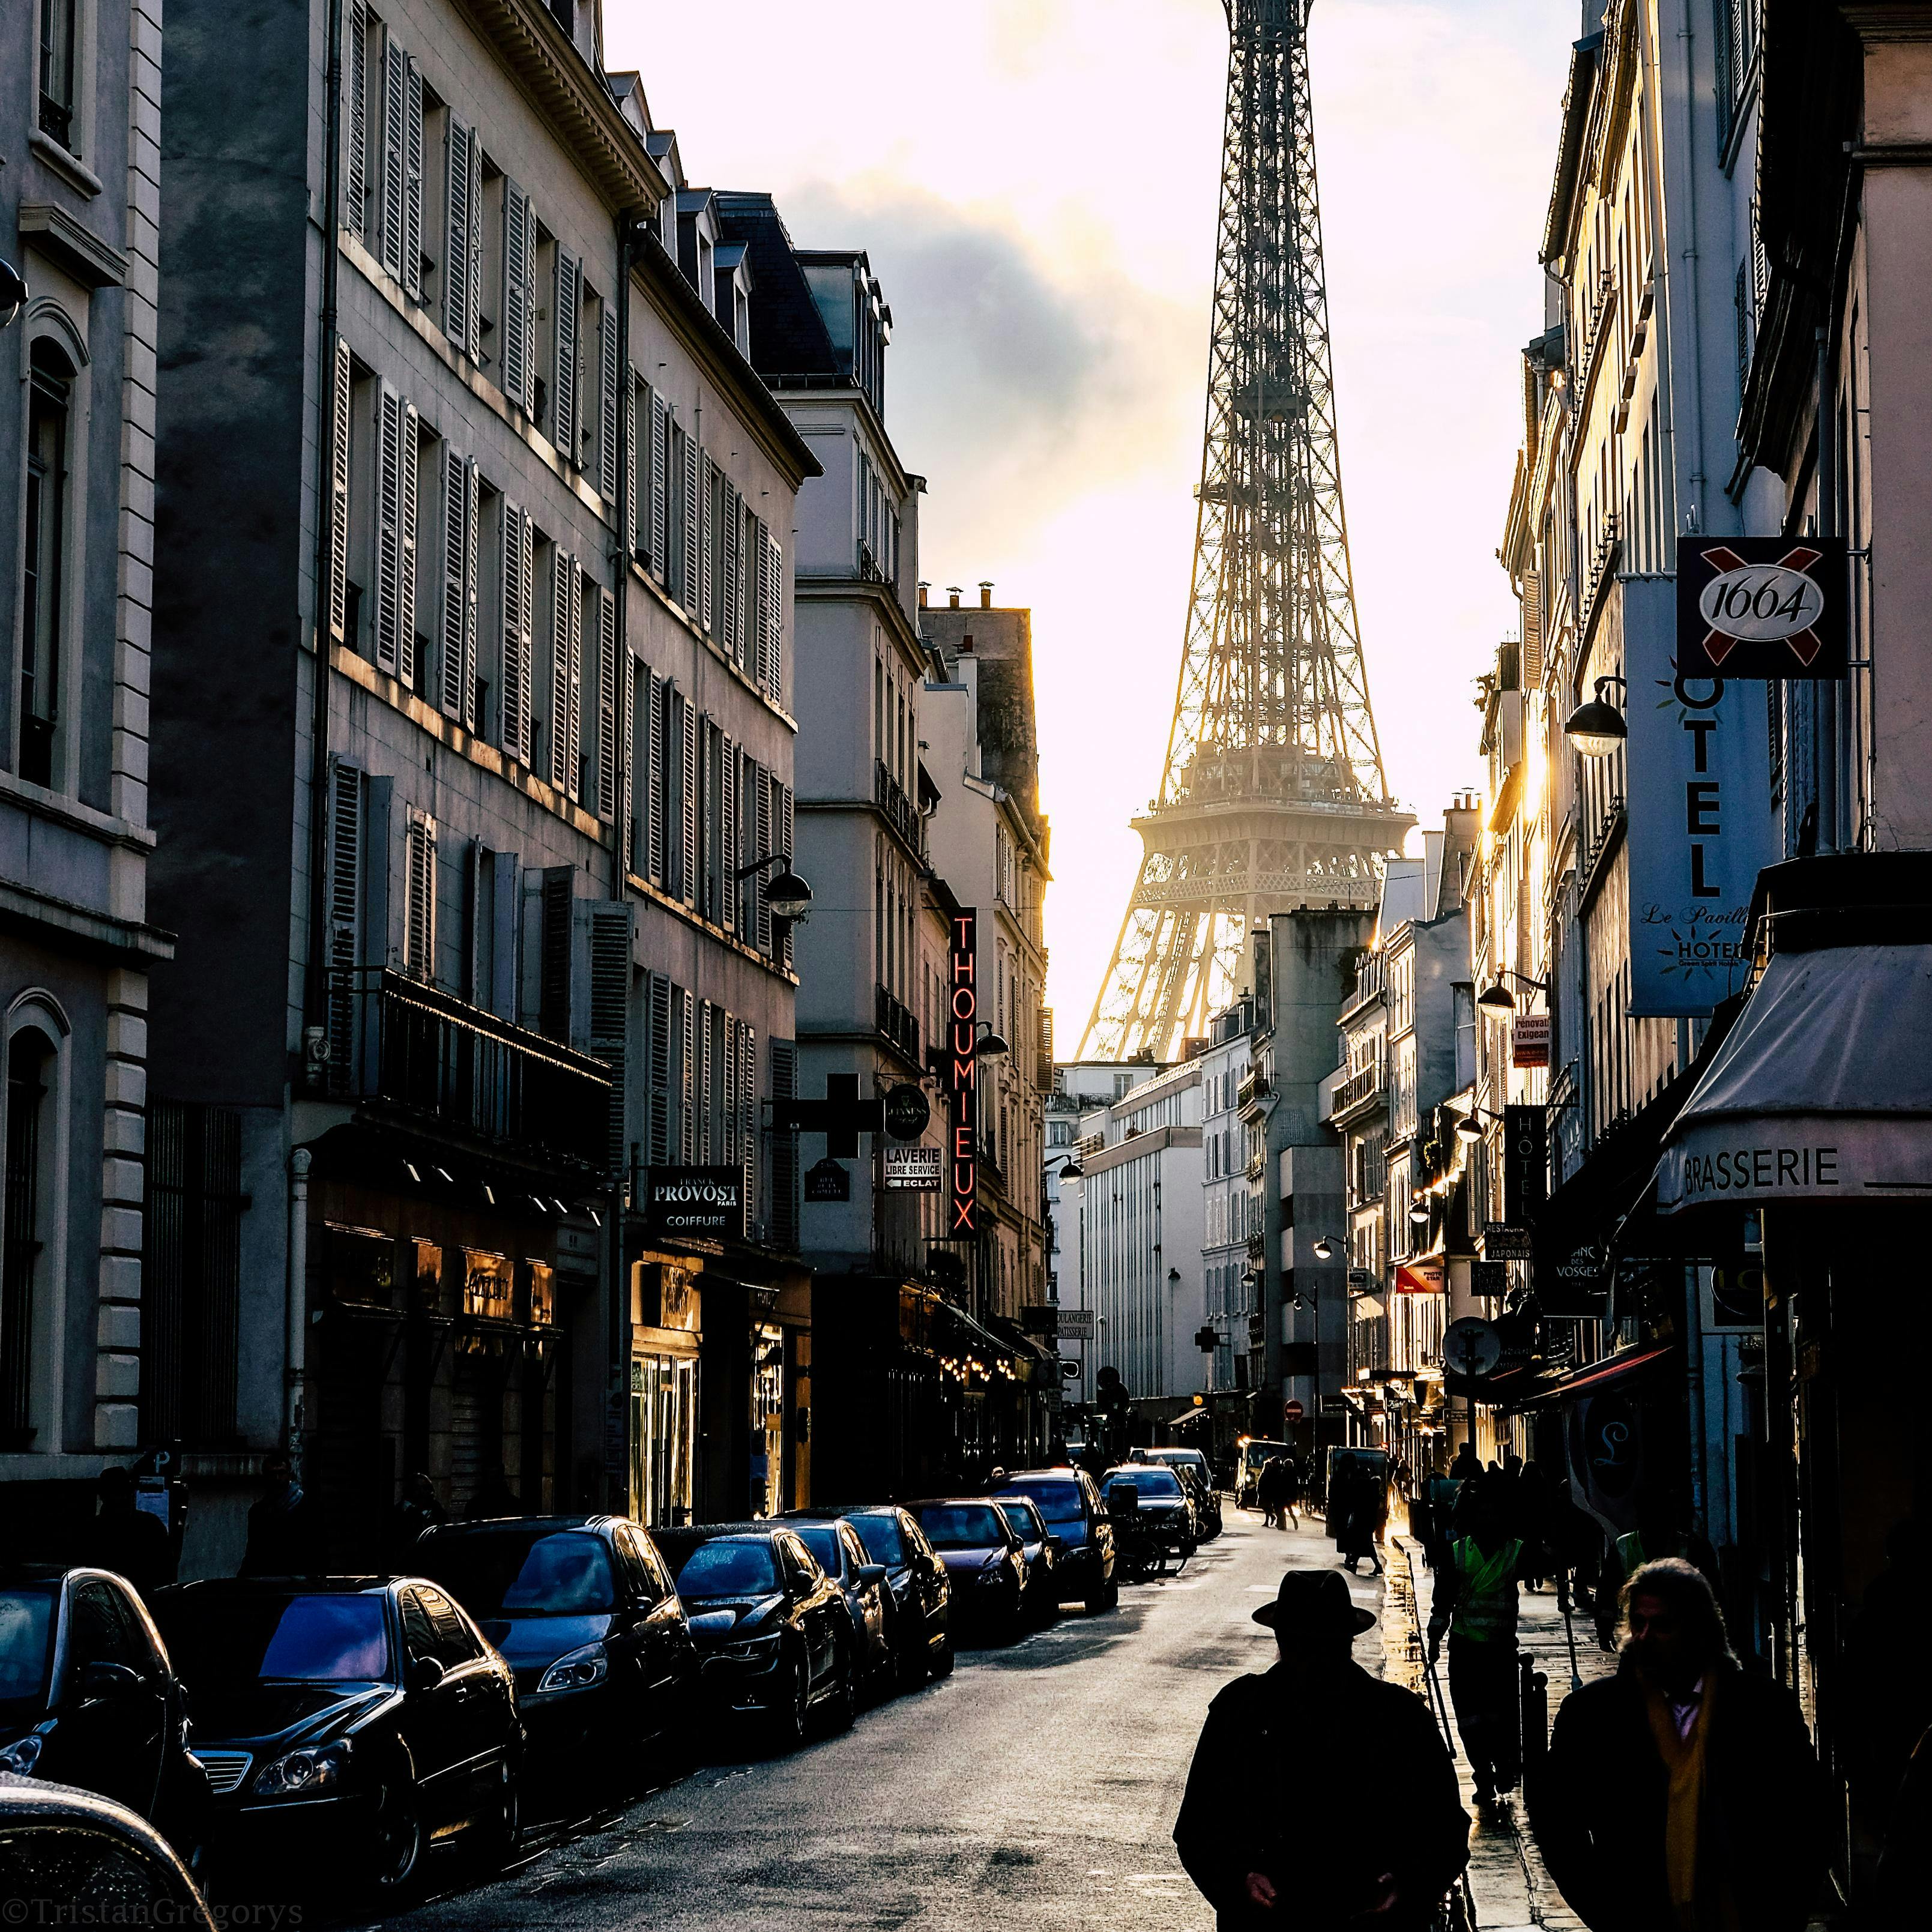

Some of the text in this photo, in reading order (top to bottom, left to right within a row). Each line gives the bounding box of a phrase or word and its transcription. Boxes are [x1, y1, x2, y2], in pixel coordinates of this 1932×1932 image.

[1712, 575, 1811, 623] 1664
[1640, 902, 1672, 924] Le
[953, 917, 975, 1230] THOUMIEUX
[886, 1149, 940, 1164] LAVERIE
[886, 1165, 940, 1175] LIBRE SERVICE
[1518, 1117, 1533, 1216] HÔTEL
[1684, 1148, 1840, 1195] BRASSERIE
[654, 1186, 739, 1201] PROVOST
[666, 1216, 726, 1227] COIFFURE
[1491, 1249, 1530, 1258] JAPONAIS
[1058, 1327, 1087, 1338] PATISSERIE
